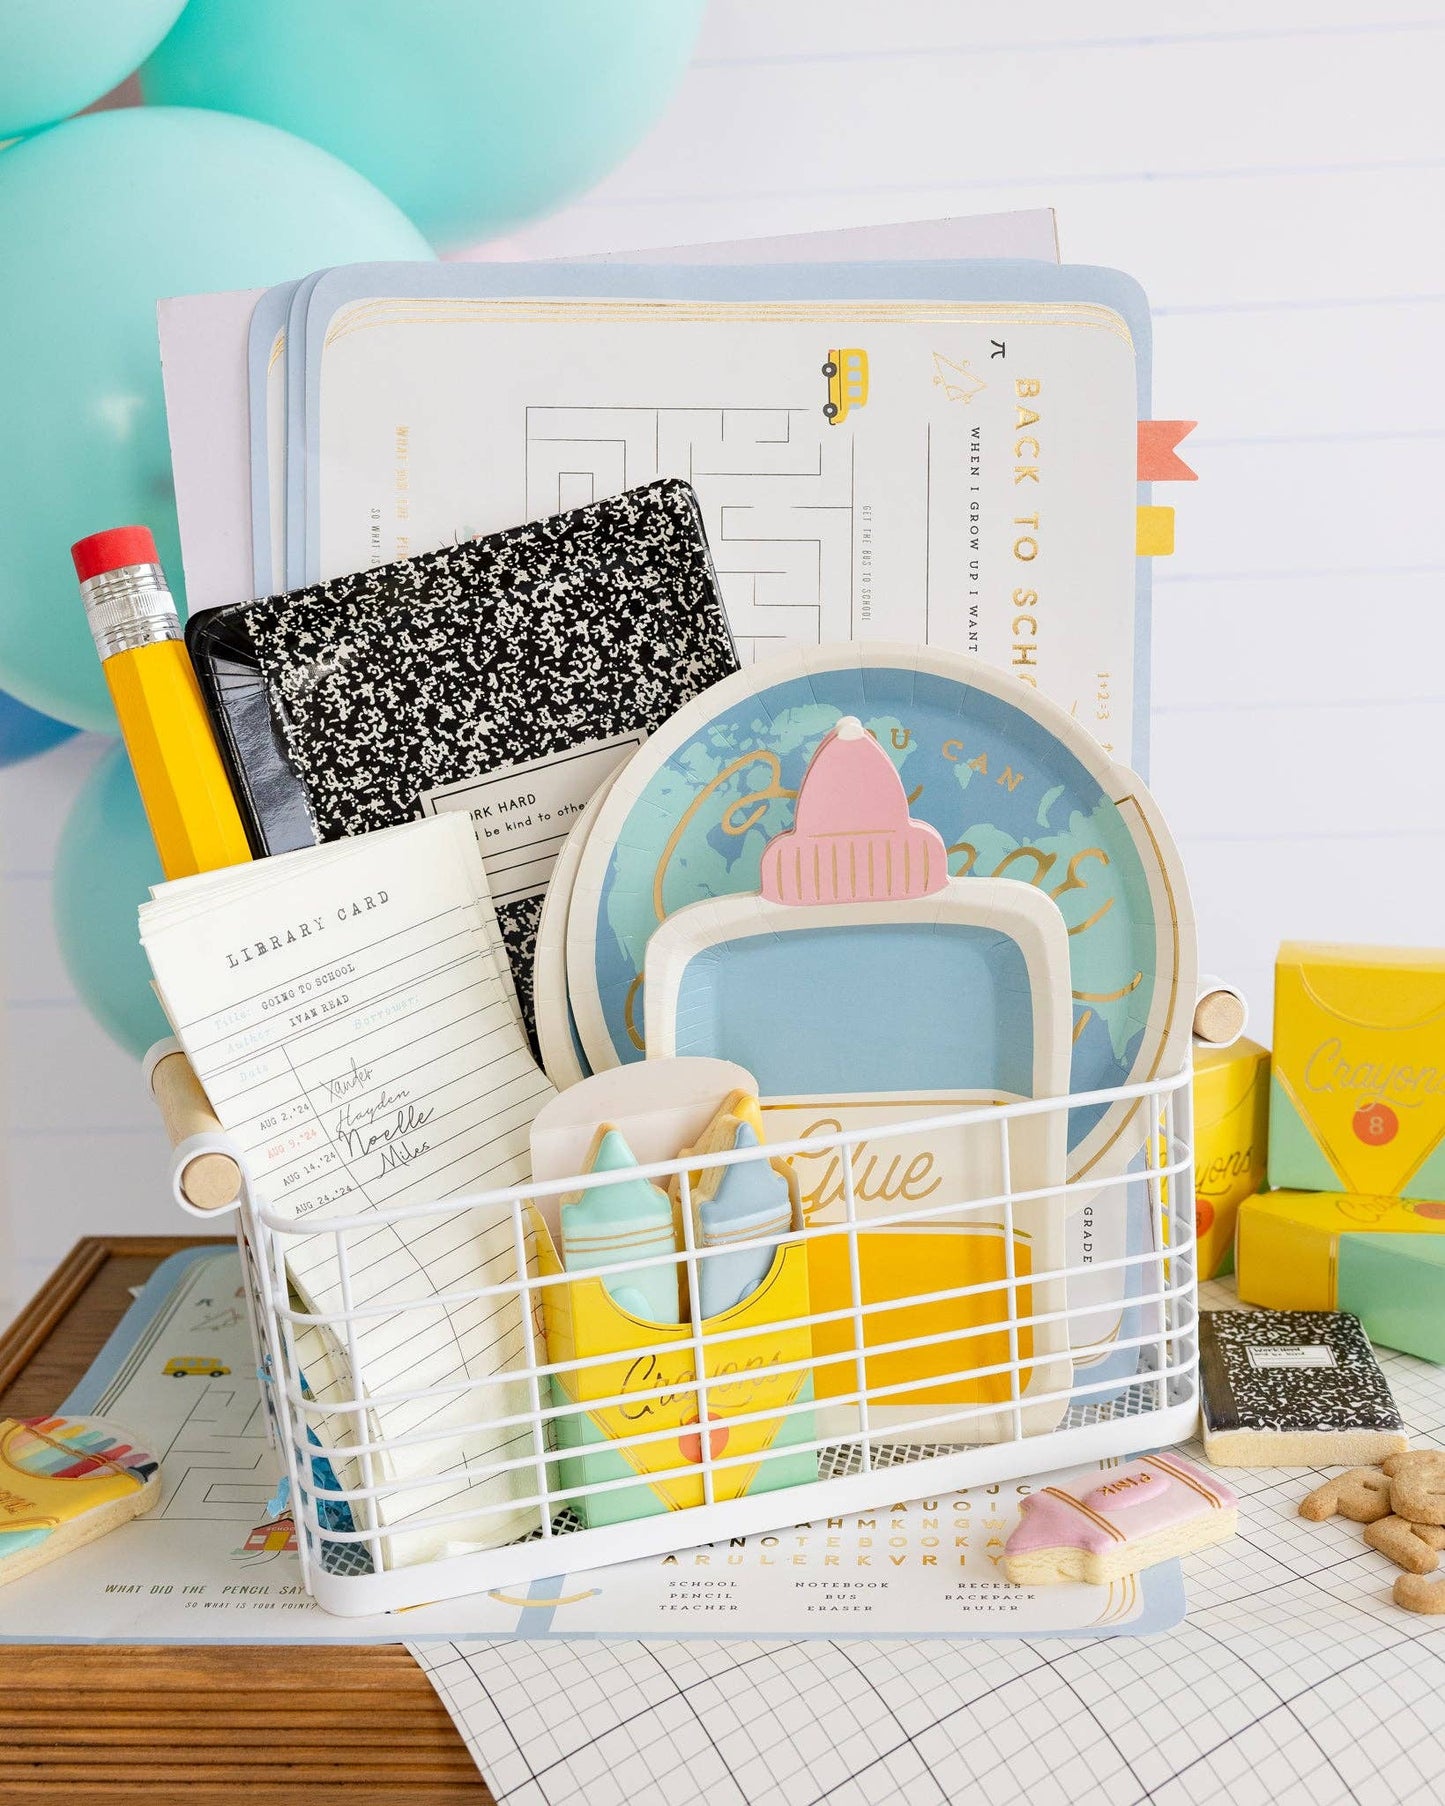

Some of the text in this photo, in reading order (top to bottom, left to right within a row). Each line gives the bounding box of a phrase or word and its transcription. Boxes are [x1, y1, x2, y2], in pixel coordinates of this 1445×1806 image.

[970, 426, 981, 476] WHEN
[1013, 378, 1041, 485] BACK
[371, 508, 380, 520] SO
[970, 501, 980, 550] GROW
[371, 525, 381, 548] WHAT
[1012, 511, 1040, 563] TO
[861, 505, 872, 621] GET THE BUS TO SCHOOL
[969, 560, 979, 581] UP
[968, 604, 979, 652] WANT
[941, 739, 1025, 792] CAN
[484, 828, 500, 839] be
[505, 815, 533, 832] kind
[538, 812, 551, 823] to
[557, 801, 588, 817] othe
[497, 793, 536, 814] HARD
[226, 890, 389, 969] LIBRARY CARD
[261, 990, 295, 1010] GOING
[298, 982, 312, 994] TO
[315, 963, 356, 987] SCHOOL
[289, 1008, 318, 1027] IVAN
[322, 994, 350, 1013] READ
[319, 1057, 373, 1103] Xander
[260, 1117, 277, 1131] AUG
[336, 1090, 410, 1133] Hayden
[338, 1105, 434, 1157] Noelle
[1369, 1116, 1384, 1136] 8
[267, 1143, 286, 1160] AUG
[376, 1141, 430, 1179] Miles
[786, 1118, 943, 1218] Glue
[283, 1171, 300, 1187] AUG
[295, 1199, 313, 1215] AUG
[1082, 1206, 1093, 1264] GRADE
[105, 1584, 306, 1595] WHAT DID THE PENCIL SAY
[184, 1601, 199, 1609] SO
[204, 1601, 230, 1609] WHAT
